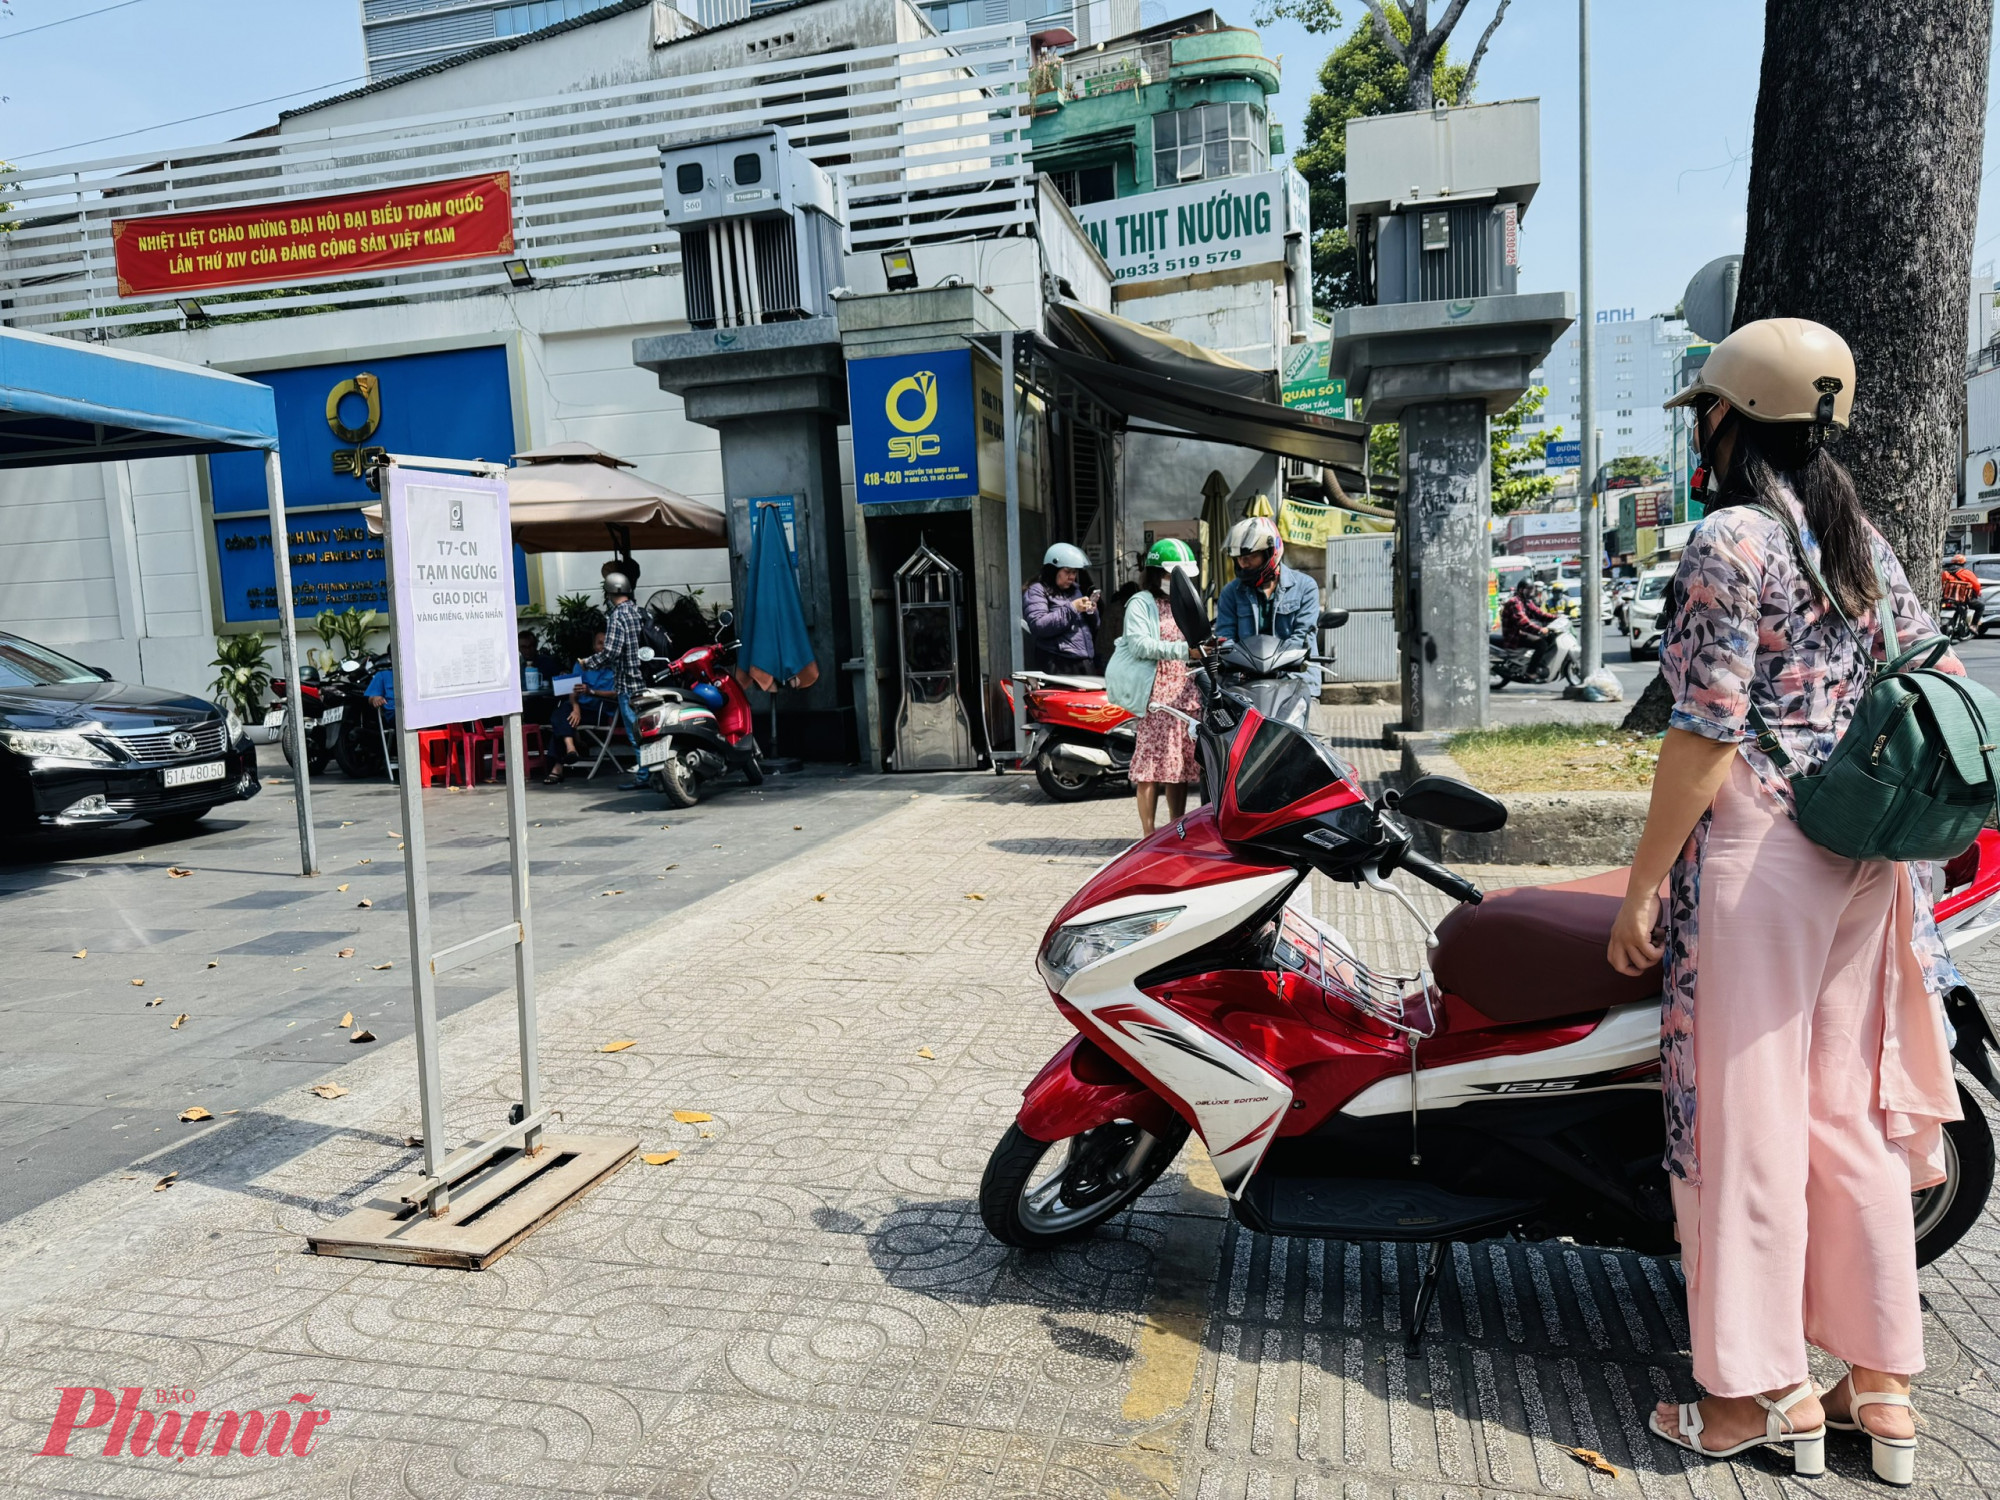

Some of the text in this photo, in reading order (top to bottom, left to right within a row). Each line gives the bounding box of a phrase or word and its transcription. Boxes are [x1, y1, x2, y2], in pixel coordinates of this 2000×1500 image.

[138, 191, 484, 252] NHIỆT LIỆT CHÀO MỪNG ĐẠI HỘI ĐẠI BIỂU TOÀN QUỐC
[1116, 209, 1168, 259] THỊT
[1178, 189, 1271, 246] NƯỚNG
[169, 226, 456, 274] LẦN THỨ XIV CỦA ĐẢNG CỘNG SẢN VIỆT NAM
[1116, 250, 1241, 280] 0933 519 579
[1282, 382, 1342, 402] QUÁN SỐ 1
[864, 471, 902, 486] 418-420
[437, 540, 478, 556] T7-CN
[417, 563, 497, 585] TẠM NGƯNG
[432, 592, 488, 608] GIAO DỊCH
[417, 612, 438, 622] VÀNG
[465, 610, 484, 620] VÀNG
[166, 763, 224, 785] 51A-480.50
[1496, 1080, 1580, 1093] 125
[1234, 1096, 1268, 1104] EDITION
